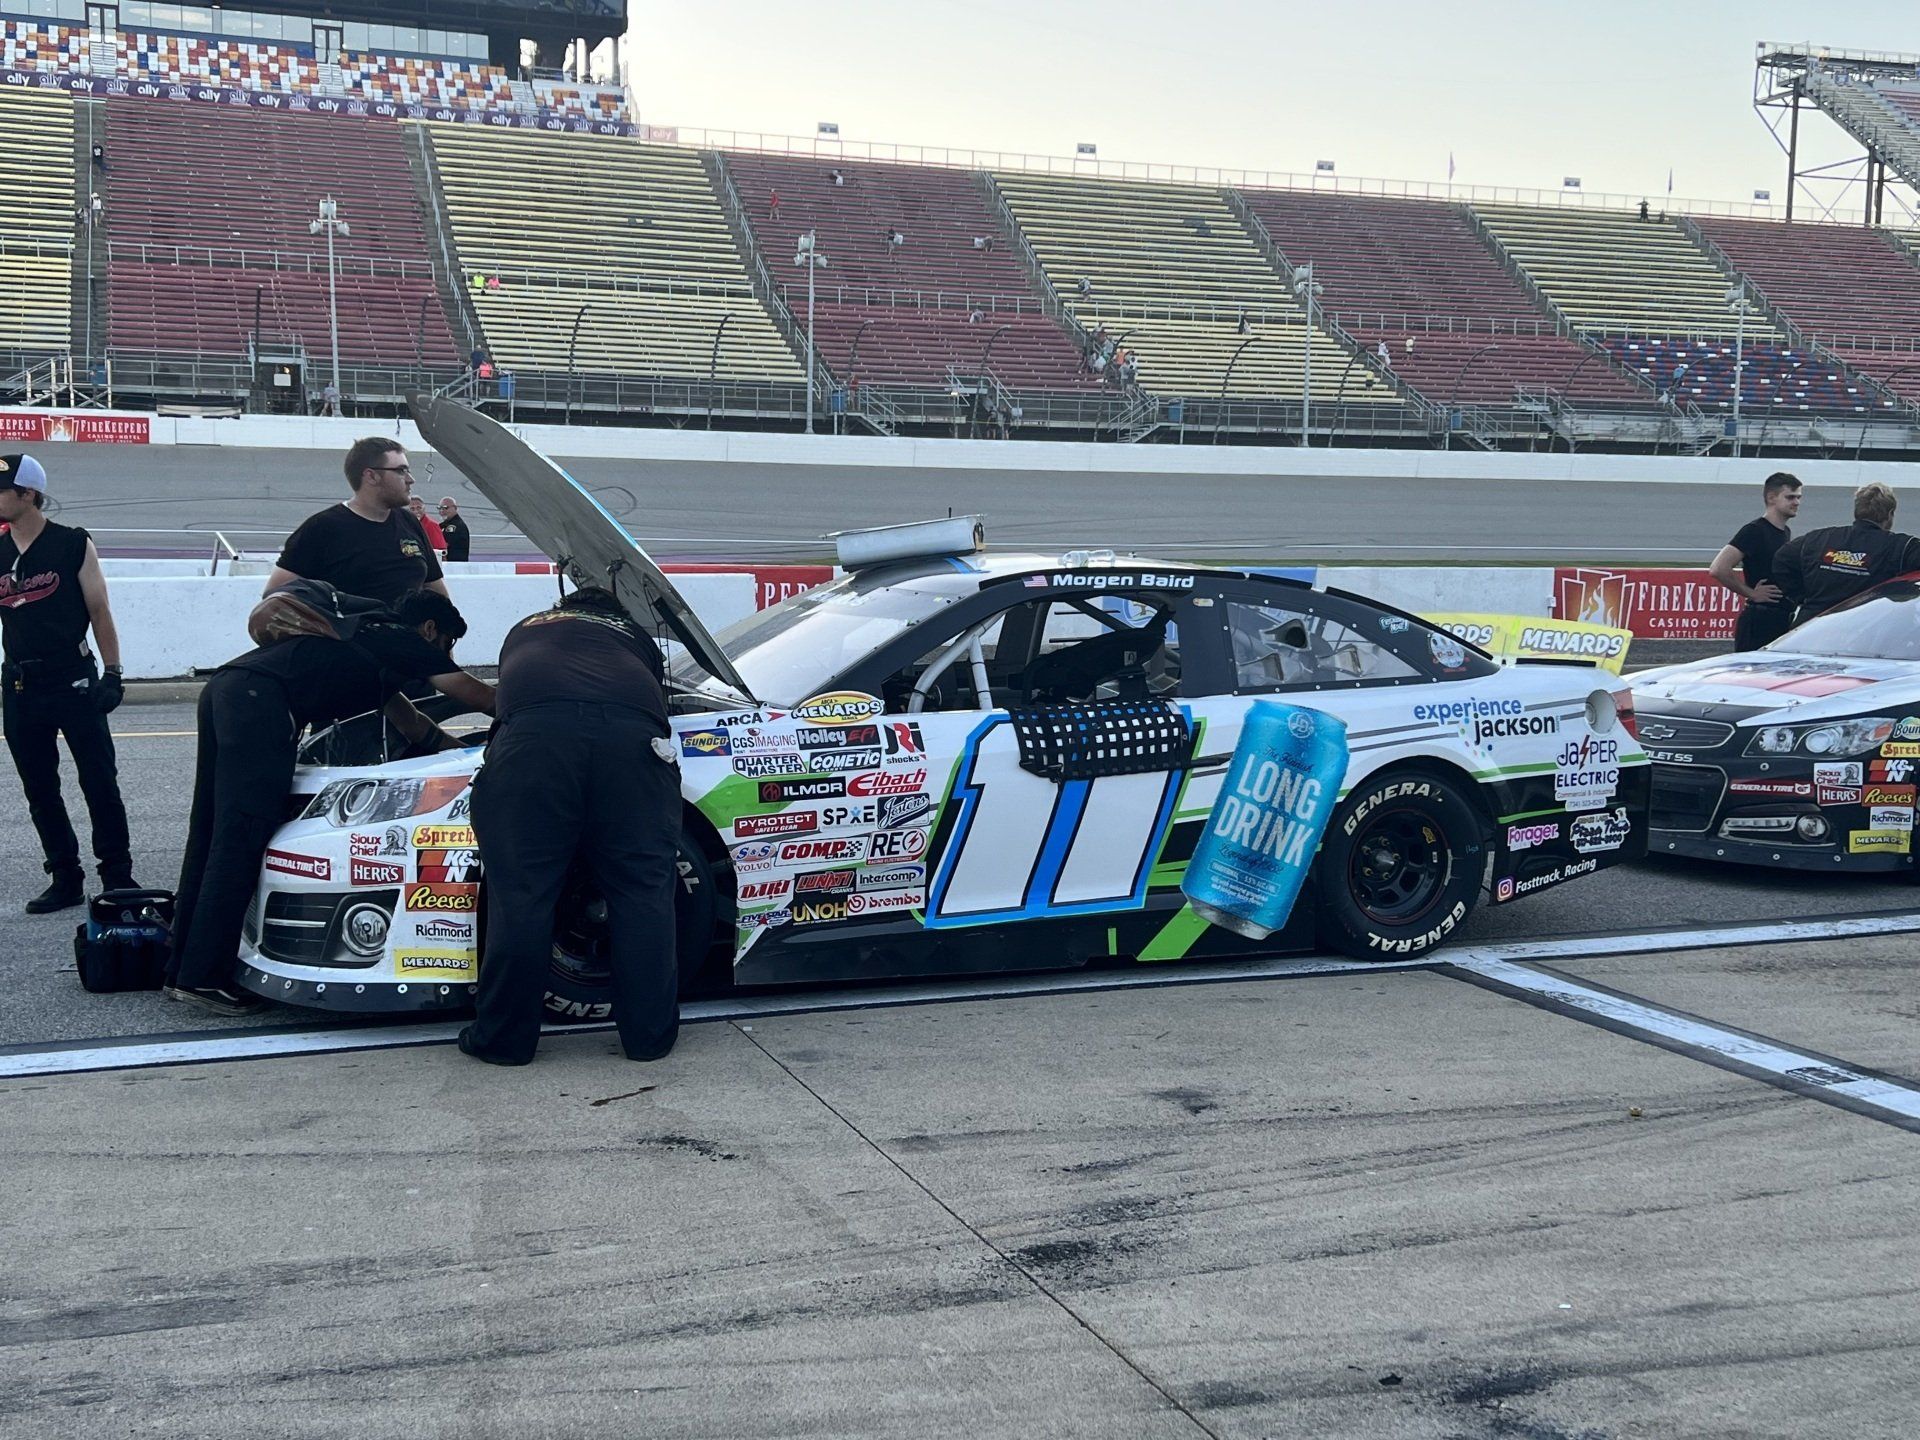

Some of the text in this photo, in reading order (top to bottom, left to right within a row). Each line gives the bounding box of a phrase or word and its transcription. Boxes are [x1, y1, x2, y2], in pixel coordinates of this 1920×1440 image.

[7, 73, 30, 87] ally
[71, 78, 94, 92] ally
[137, 84, 160, 98] ally
[198, 89, 220, 103] ally
[259, 94, 280, 108] ally
[318, 99, 339, 113] ally
[376, 104, 396, 117] ally
[435, 109, 456, 123] ally
[491, 114, 512, 128] ally
[546, 119, 566, 132] ally
[600, 124, 619, 137] ally
[1053, 573, 1194, 589] Morgen Baird
[1637, 582, 1750, 612] FIREKEEPE
[1649, 617, 1699, 628] CASINO
[1438, 623, 1494, 645] ARDS
[1518, 626, 1624, 657] MENARDS
[1663, 630, 1735, 639] BATTLE CREEK
[790, 700, 884, 720] MENARDS
[1413, 697, 1522, 725] experience
[716, 712, 763, 727] ARCA
[797, 728, 847, 746] Holley
[1474, 713, 1556, 746] jackson
[684, 737, 728, 747] SUNOCO
[735, 755, 798, 772] QUARTER
[811, 752, 880, 770] COMETIC
[886, 755, 920, 765] shocks
[1674, 753, 1693, 763] SS
[747, 764, 803, 777] MASTER
[847, 768, 927, 797] Eibach
[1557, 770, 1617, 788] ELECTRIC
[1730, 783, 1771, 791] GENERAL
[1816, 777, 1840, 785] Chief
[783, 783, 843, 797] ILMOR
[1236, 753, 1321, 822] LONG
[1822, 789, 1857, 801] HERR'S
[1864, 788, 1913, 804] Reese's
[739, 814, 812, 829] PYROTECT
[1871, 811, 1911, 823] Richmond
[350, 834, 382, 845] Sioux
[1213, 795, 1315, 868] DRINK
[1508, 824, 1559, 847] Forager
[1855, 836, 1905, 845] MENARDS
[350, 845, 380, 856] Chief
[781, 841, 847, 860] COMP
[825, 851, 857, 860] CAMS
[266, 856, 297, 870] GENERAL
[296, 862, 314, 873] TIRE
[737, 862, 770, 873] VOLVO
[353, 864, 399, 882] HERR'S
[860, 872, 917, 884] Intercomp
[1515, 858, 1597, 894] Fasttrack_Racing
[408, 886, 476, 910] Reese's
[869, 893, 922, 908] brembo
[793, 902, 847, 922] UNOH
[415, 922, 473, 938] Richmond
[1367, 901, 1466, 953] GENERAL
[402, 957, 470, 970] MENARDS
